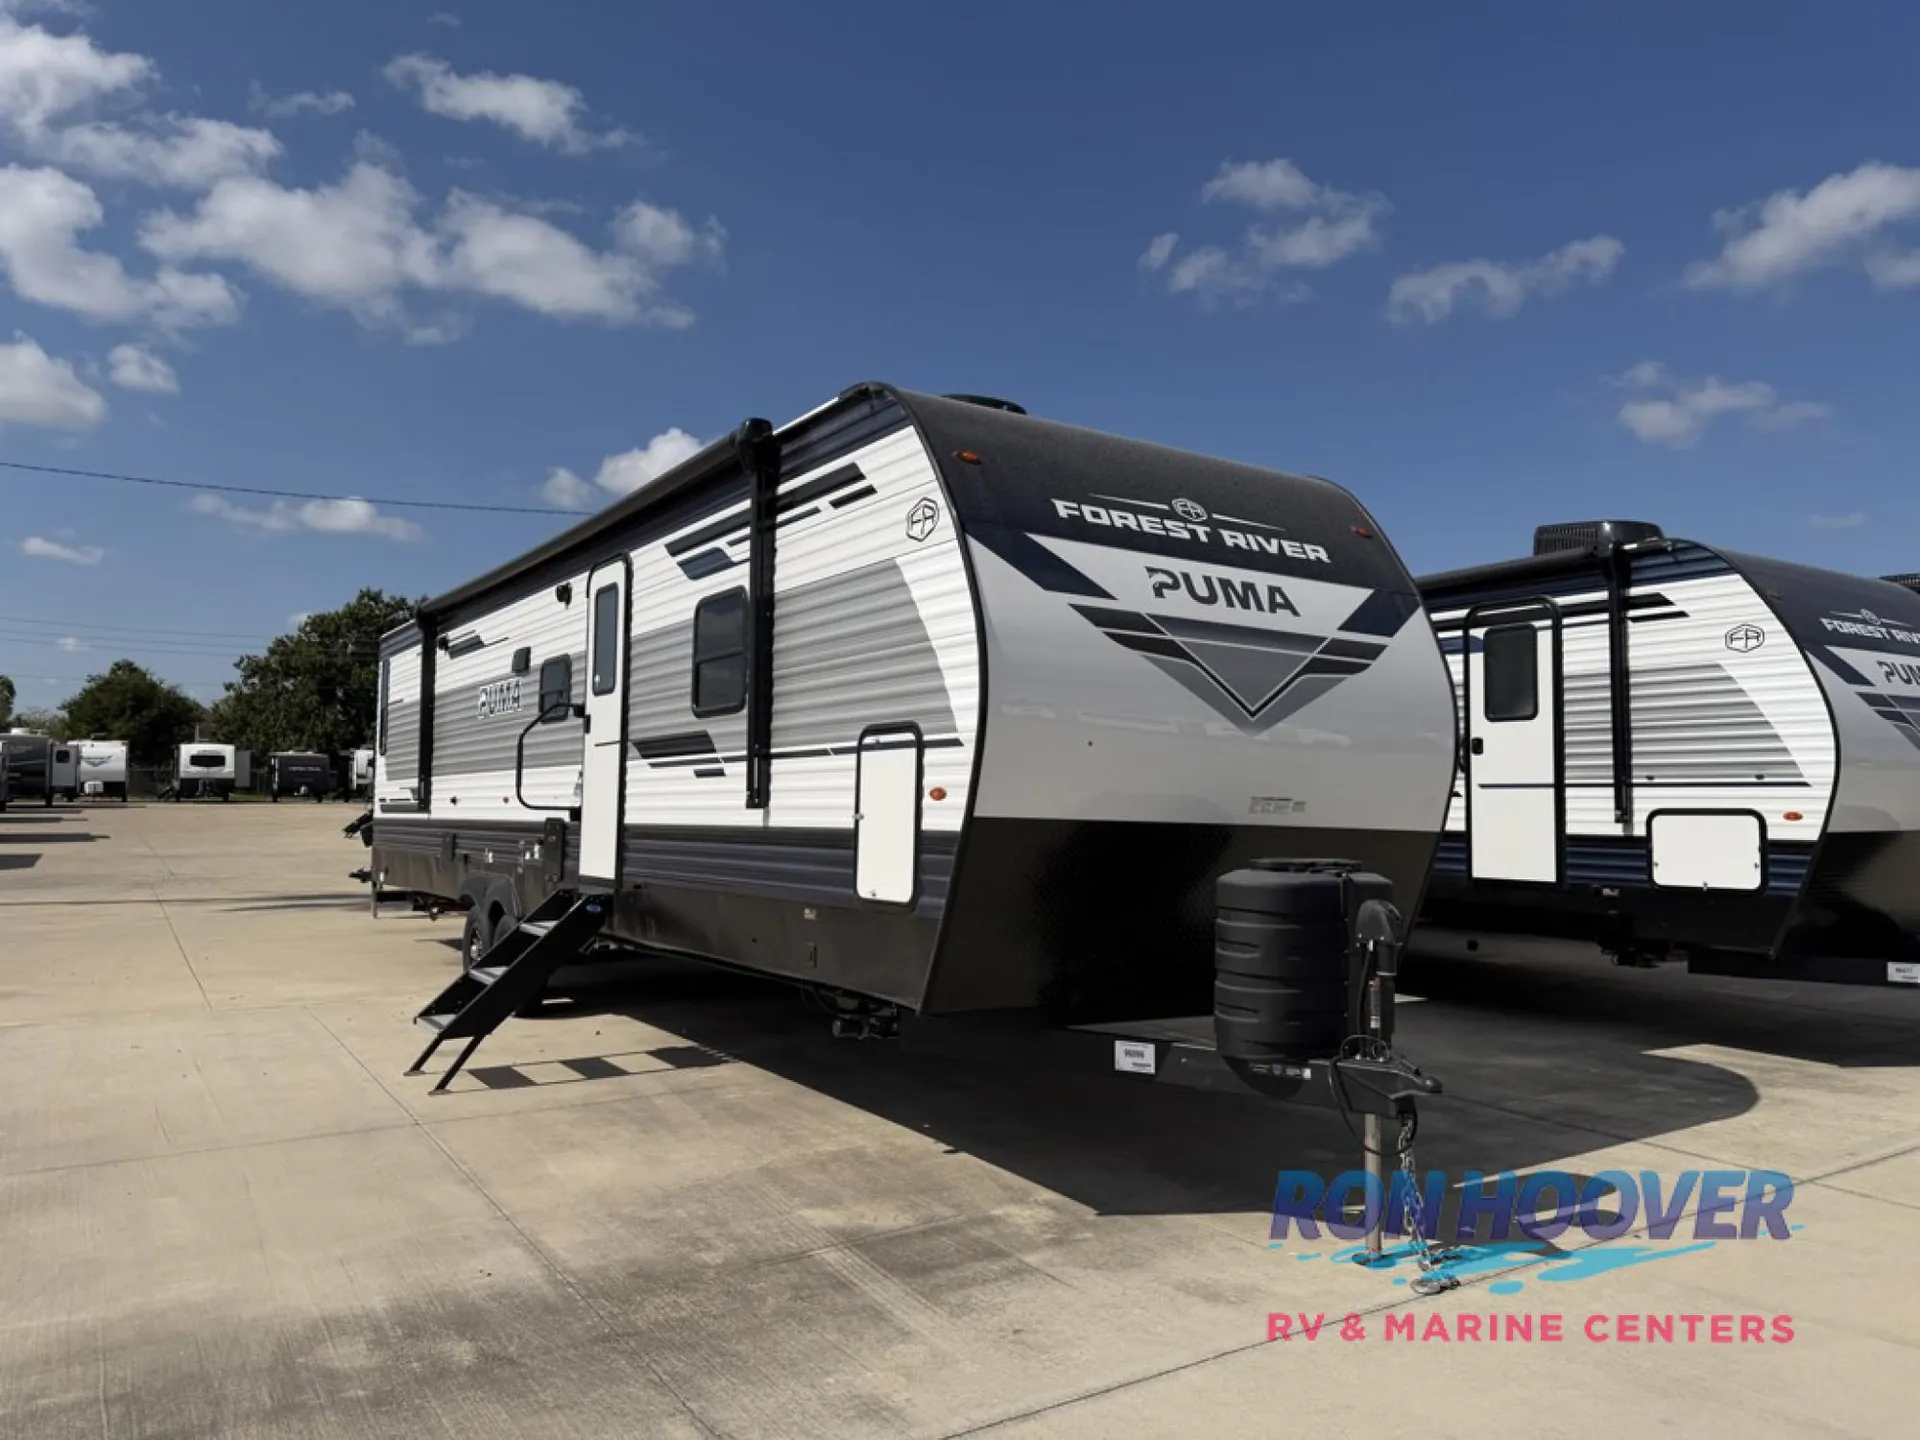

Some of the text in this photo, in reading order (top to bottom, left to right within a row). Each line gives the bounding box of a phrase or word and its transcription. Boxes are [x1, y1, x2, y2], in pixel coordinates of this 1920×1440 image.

[1051, 498, 1332, 563] FOREST RIVER
[1145, 566, 1301, 617] PUMA
[1820, 617, 1890, 640] FOREST
[478, 678, 522, 719] PUMA
